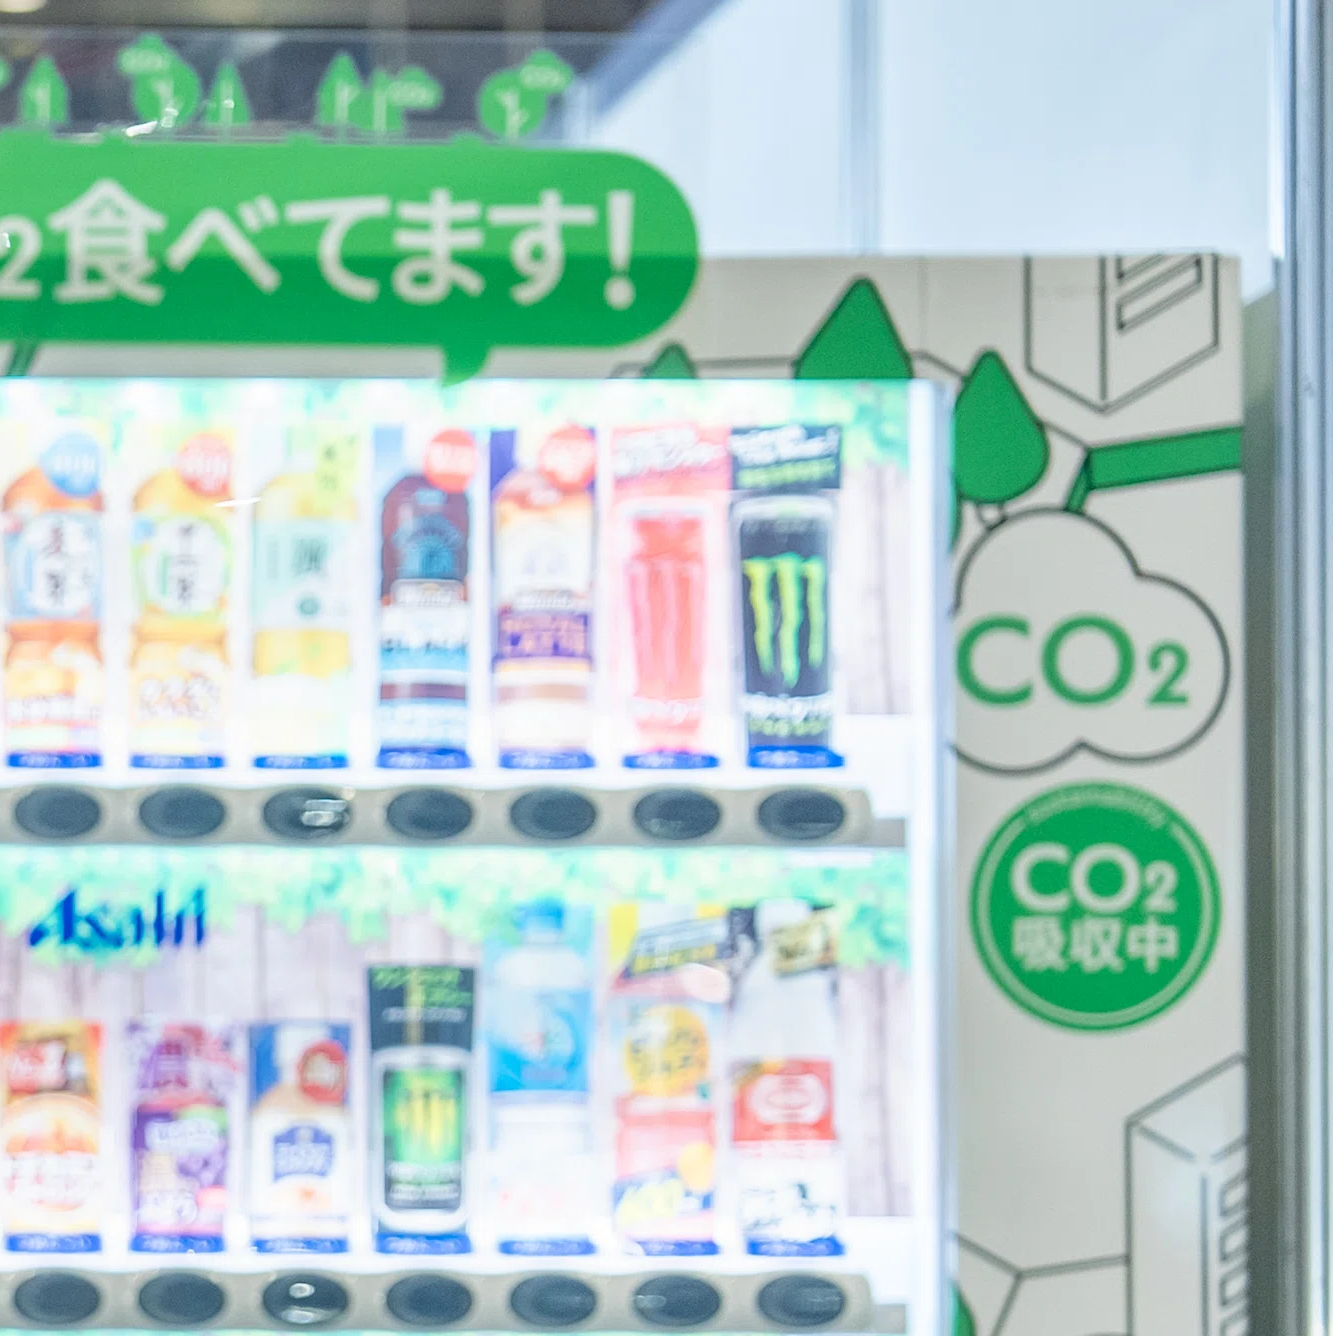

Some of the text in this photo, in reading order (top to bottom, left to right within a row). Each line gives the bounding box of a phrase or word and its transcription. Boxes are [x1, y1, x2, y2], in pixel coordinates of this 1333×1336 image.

[955, 613, 1191, 709] CO2
[1010, 842, 1179, 914] CO2
[28, 885, 207, 951] Asahi
[1011, 915, 1180, 974] 吸収中
